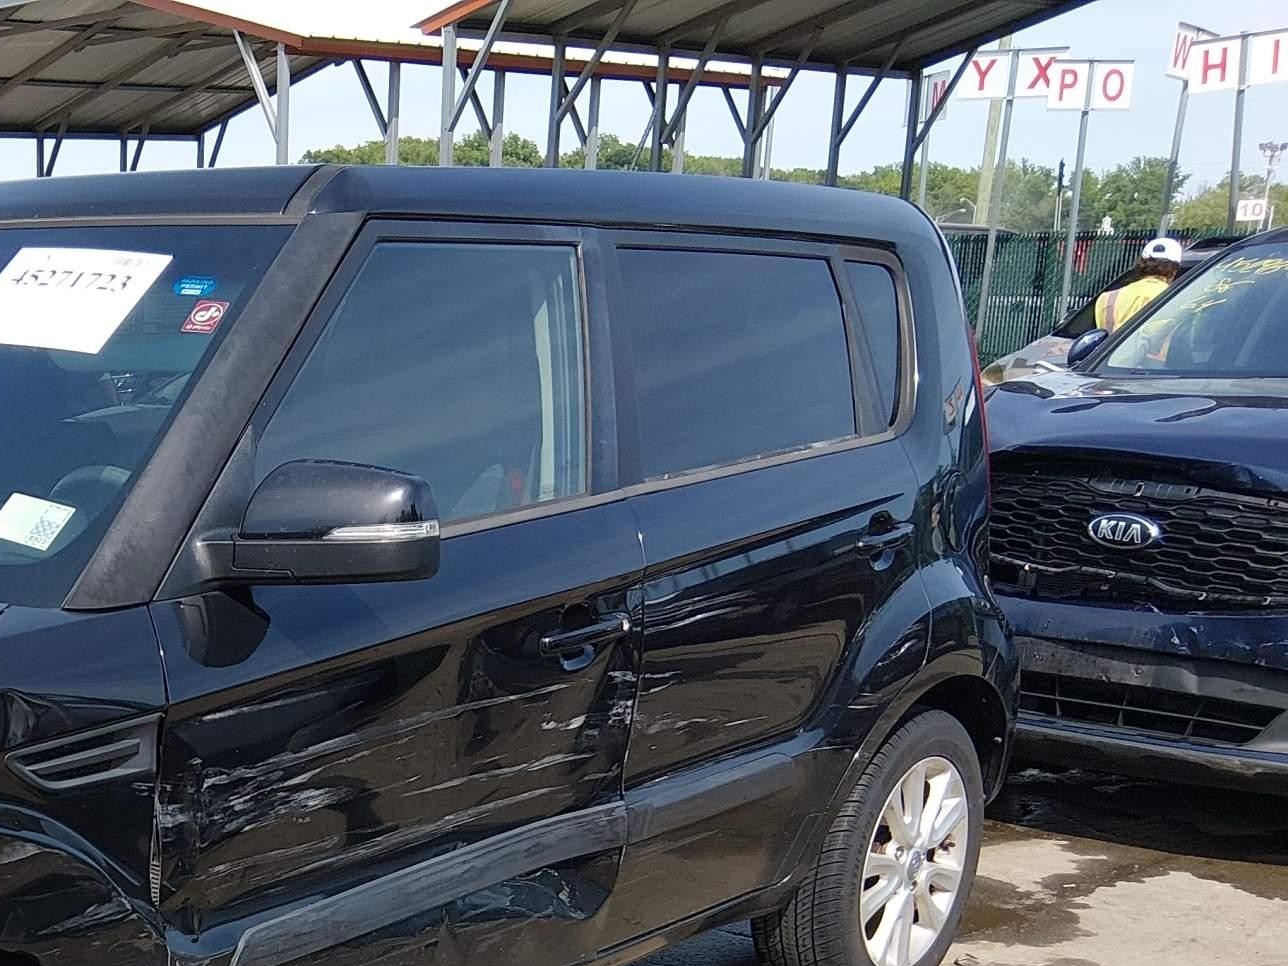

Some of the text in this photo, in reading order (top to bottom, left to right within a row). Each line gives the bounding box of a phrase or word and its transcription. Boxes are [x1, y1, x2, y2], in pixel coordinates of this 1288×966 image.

[1026, 56, 1057, 89] X
[1201, 46, 1228, 85] H
[1271, 38, 1281, 74] I
[972, 58, 998, 91] Y
[1058, 69, 1078, 101] P
[1102, 68, 1125, 102] O
[1239, 202, 1264, 217] 10
[11, 269, 133, 292] 45271723
[1097, 519, 1142, 544] KIA
